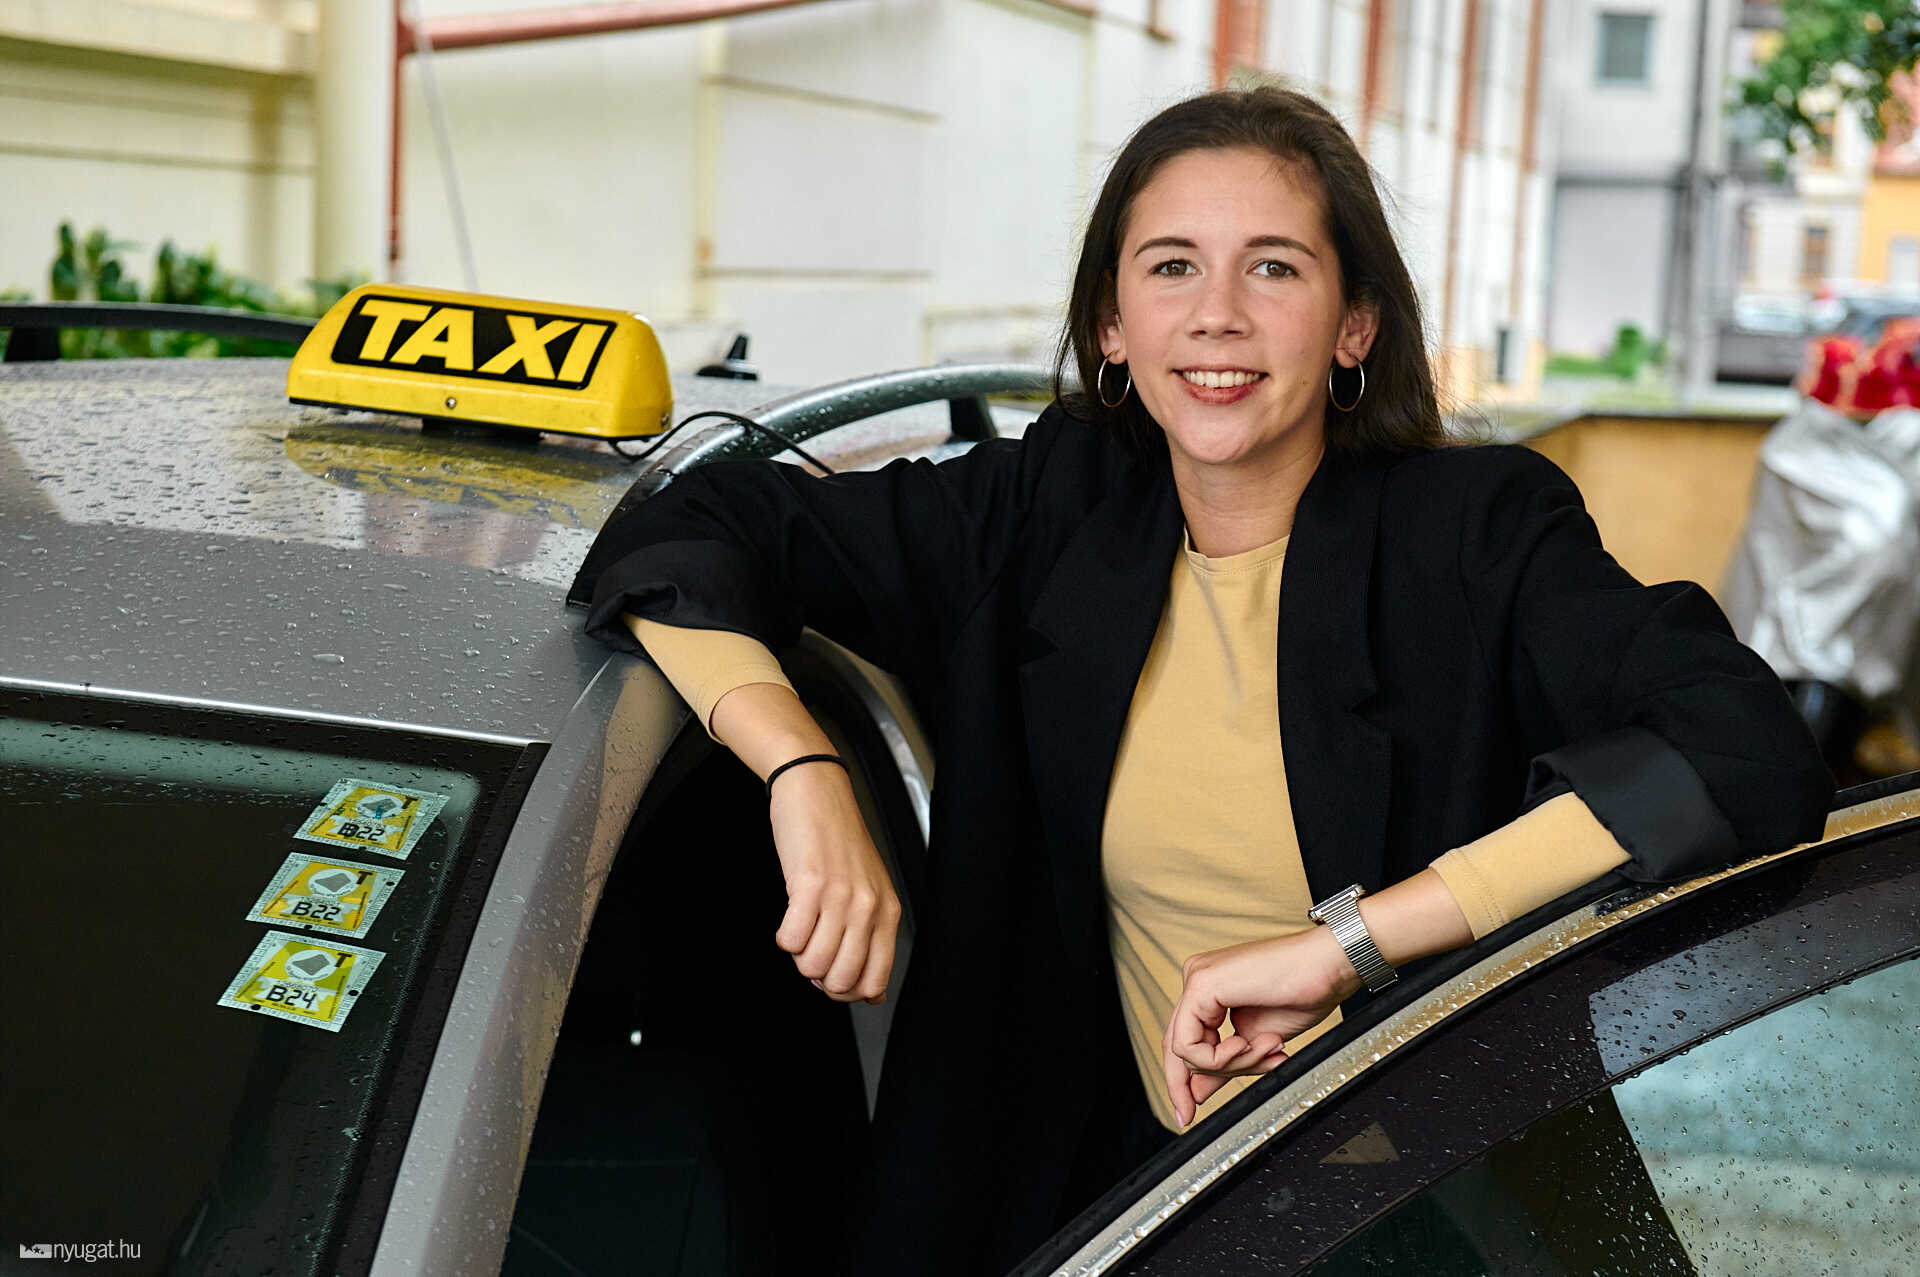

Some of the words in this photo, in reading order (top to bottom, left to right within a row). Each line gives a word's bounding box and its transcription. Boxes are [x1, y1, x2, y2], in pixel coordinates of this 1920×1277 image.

[358, 299, 609, 383] TAXI
[401, 795, 420, 810] T
[355, 870, 373, 885] T
[291, 901, 341, 921] B22
[333, 951, 352, 968] T
[265, 984, 317, 1008] B24
